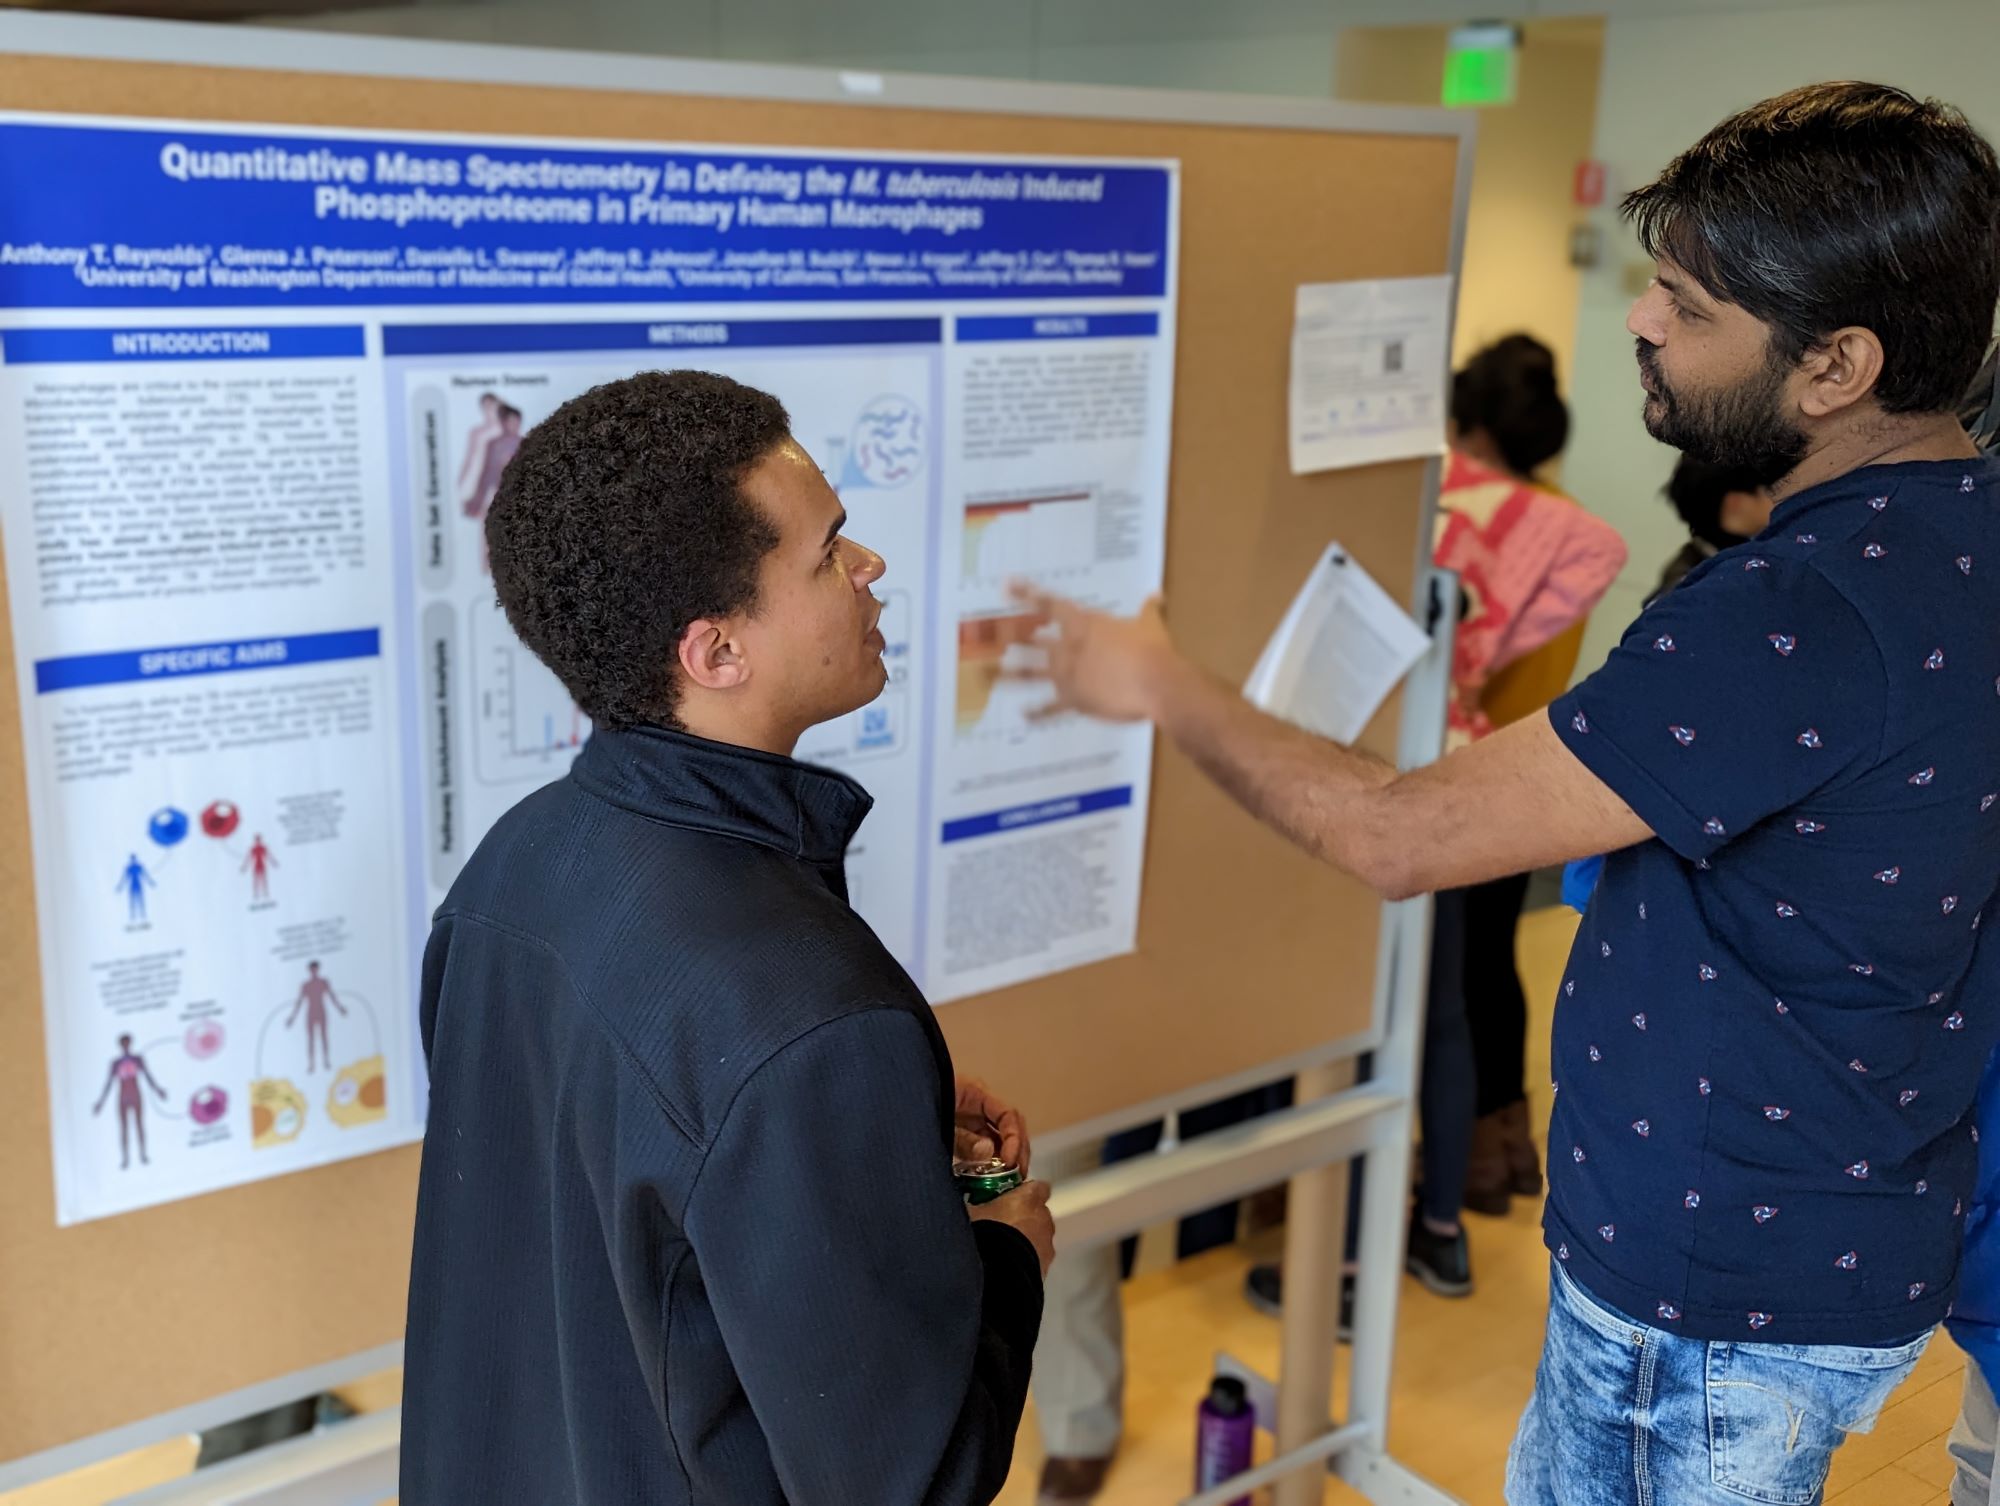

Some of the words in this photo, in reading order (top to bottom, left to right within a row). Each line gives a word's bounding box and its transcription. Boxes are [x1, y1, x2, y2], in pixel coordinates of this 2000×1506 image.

[159, 142, 368, 183] Quantitative
[374, 151, 462, 187] Mass
[465, 153, 661, 196] Spectrometry
[663, 160, 692, 193] in
[694, 161, 802, 202] Defining
[804, 165, 848, 197] the
[850, 168, 882, 197] M.
[886, 168, 1019, 200] tuberculosis
[1022, 172, 1105, 203] Induced
[315, 184, 593, 230] Phosphoproteome
[597, 191, 626, 225] in
[629, 193, 736, 234] Primary
[737, 196, 828, 228] Human
[830, 199, 984, 236] Macrophages
[0, 242, 88, 268] Anthony
[89, 243, 112, 265] T.
[184, 264, 207, 288] of
[208, 265, 321, 292] Washington
[321, 265, 437, 292] Departments
[437, 266, 457, 288] of
[113, 331, 270, 356] INTRODUCTION
[648, 321, 729, 344] METHODS
[138, 642, 231, 675] SPECIFIC
[234, 639, 289, 664] AIMS
